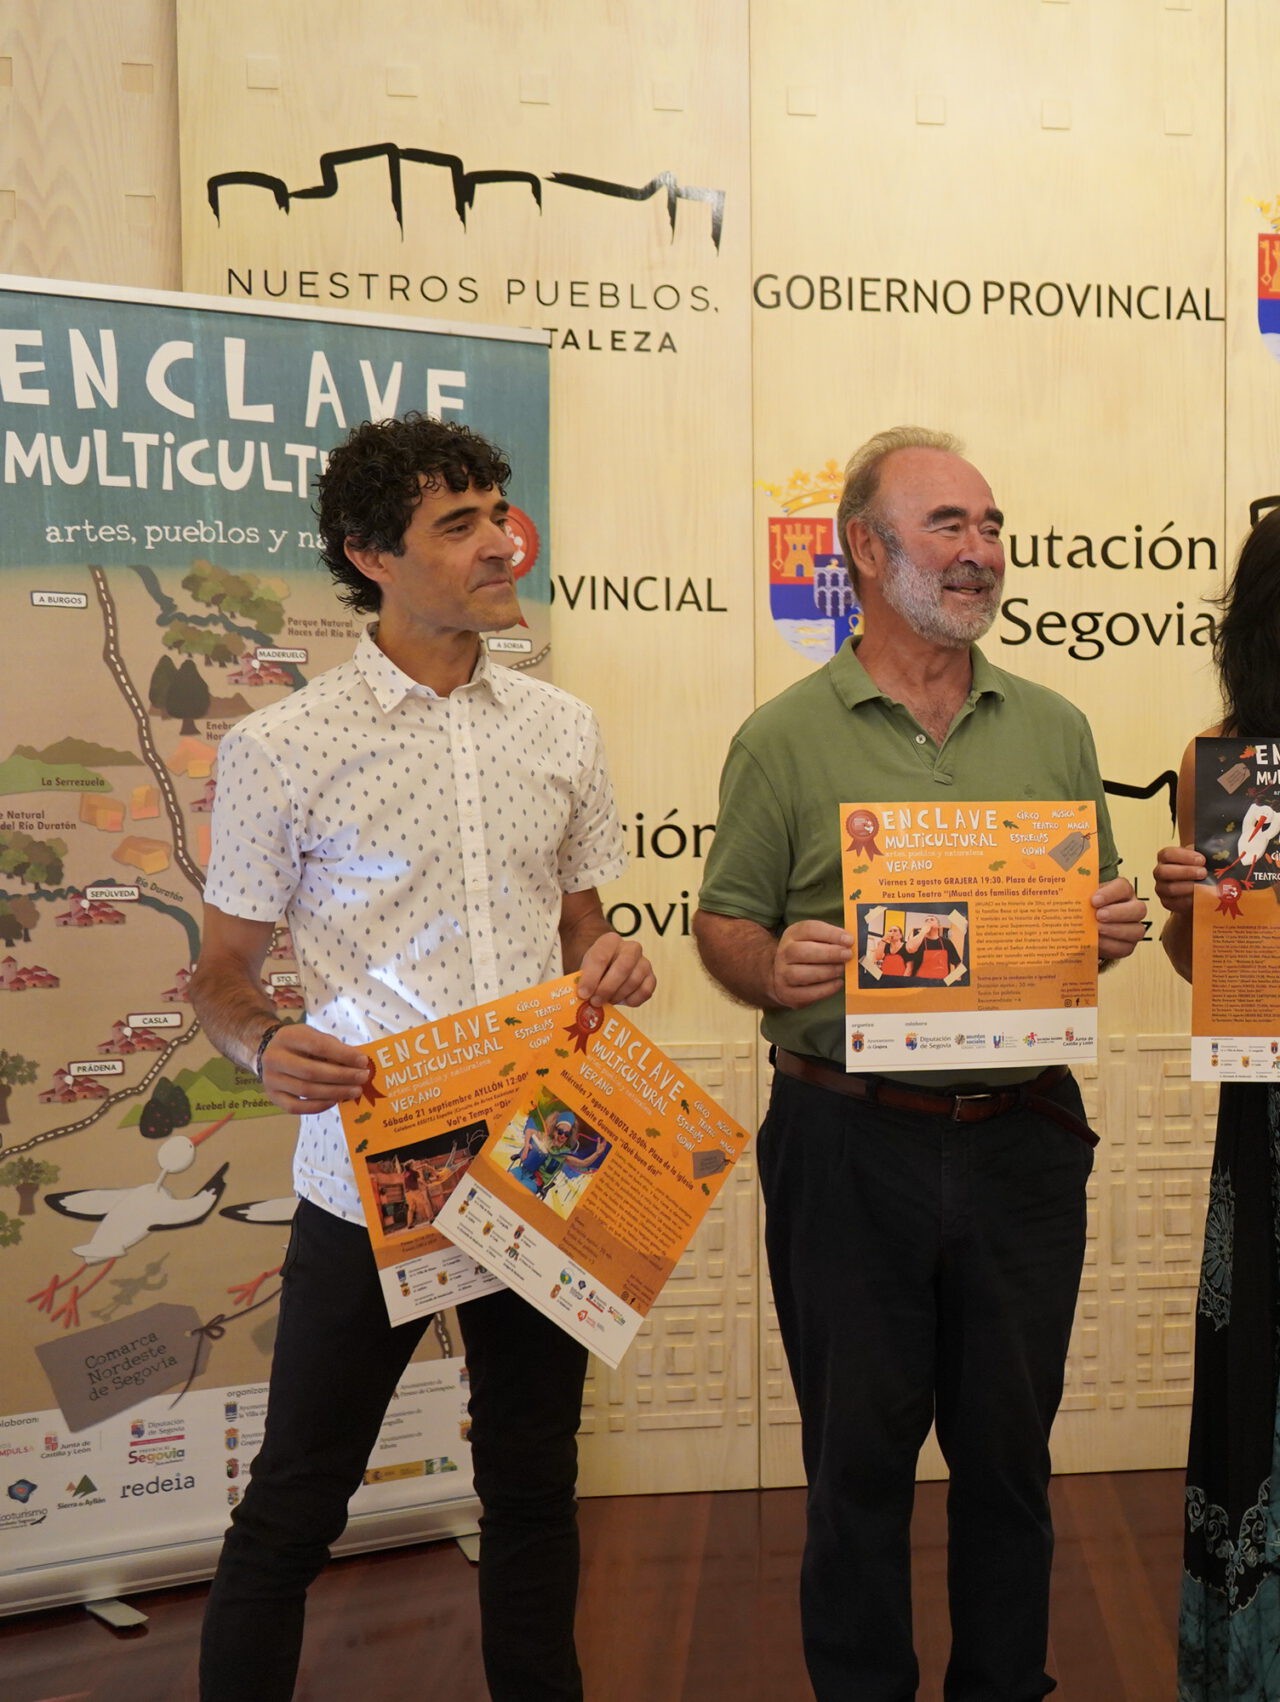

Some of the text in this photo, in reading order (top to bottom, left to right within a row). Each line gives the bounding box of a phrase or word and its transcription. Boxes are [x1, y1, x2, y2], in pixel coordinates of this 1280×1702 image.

[228, 268, 720, 313] NUESTROS PUEBLOS,
[752, 273, 1226, 322] GOBIERNO PROVINCIAL
[0, 328, 467, 424] ENCLAVE
[46, 521, 138, 547] artes,
[145, 520, 260, 550] pueblos
[268, 527, 289, 553] y
[47, 596, 83, 605] BURGOS
[288, 617, 353, 628] Parque Natural
[1000, 597, 1219, 661] Segovia
[288, 628, 328, 636] Haces del
[258, 650, 306, 660] MADERUELO
[41, 777, 105, 787] La Serrezuela
[7, 809, 45, 819] Natural
[881, 807, 999, 830] ENCLAVE
[19, 821, 34, 830] Río
[37, 821, 77, 830] Duratón
[1032, 821, 1059, 830] TEATRO
[1009, 832, 1049, 843] ESTRELLAS
[886, 859, 933, 873] VERANO
[878, 875, 1066, 888] Viernes 2 agosto GRAJERA Plaza de Grajera
[90, 888, 136, 898] SEPÚLVEDA
[150, 881, 184, 902] Duratón
[882, 888, 1020, 899] Pez Luna Teatro dos familias
[142, 1016, 168, 1025] CASLA
[377, 1011, 500, 1069] ENCLAVE
[919, 1035, 951, 1044] Diputación
[928, 1041, 952, 1050] Segovia
[601, 1018, 685, 1101] ENCLAVE
[76, 1062, 118, 1073] PRÁDENA
[579, 1062, 615, 1096] VERANO
[195, 1100, 240, 1111] Acebal de
[382, 1113, 414, 1128] Sábado
[415, 1108, 425, 1118] 21
[428, 1094, 472, 1114] septiembre
[474, 1081, 504, 1098] AYLLÓN
[391, 1086, 441, 1114] VERANO
[560, 1069, 589, 1096] Miércoles
[591, 1097, 610, 1116] agosto
[608, 1111, 630, 1134] RIBOTA
[85, 1332, 158, 1369] Comarca
[88, 1344, 167, 1385] Nordeste
[89, 1356, 178, 1401] de Segovia
[147, 1418, 185, 1429] Diputación
[158, 1426, 185, 1436] Segovia
[60, 1442, 81, 1450] Junta
[128, 1449, 185, 1465] Segovia
[120, 1472, 195, 1499] redeia
